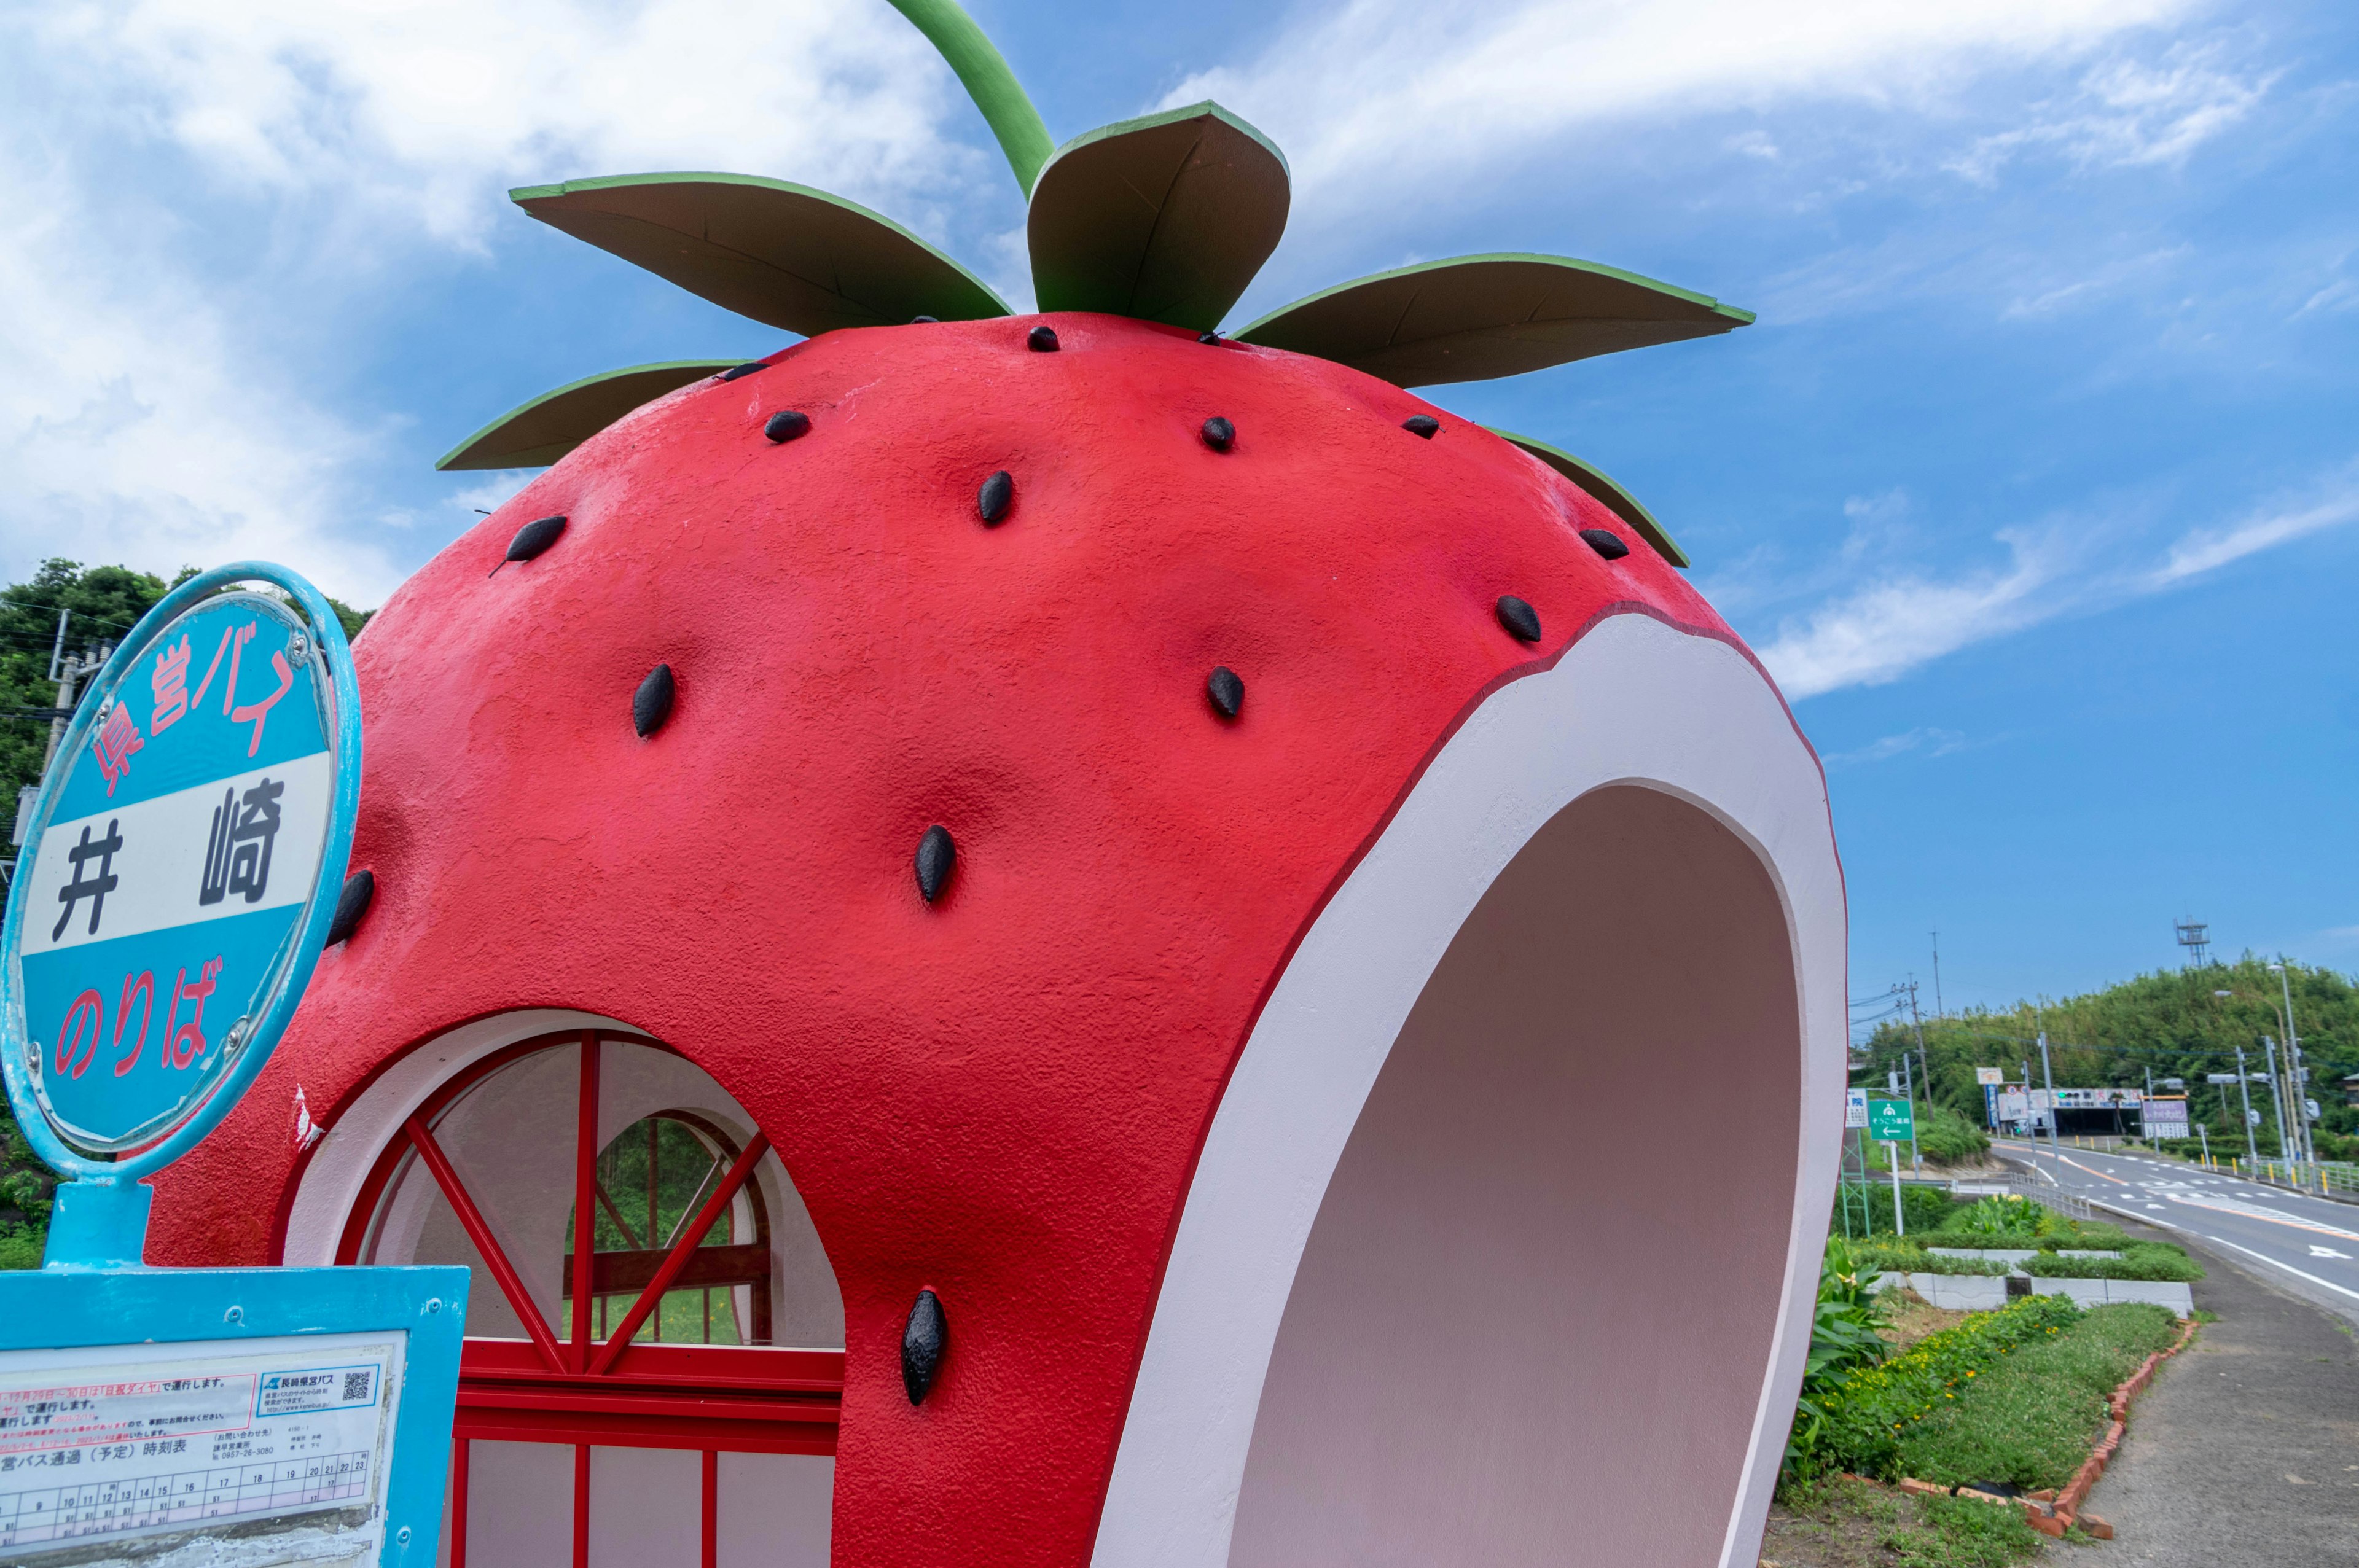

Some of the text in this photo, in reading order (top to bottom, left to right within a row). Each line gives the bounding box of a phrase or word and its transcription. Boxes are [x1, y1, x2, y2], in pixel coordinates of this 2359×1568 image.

[95, 620, 293, 798] 県営バス
[52, 778, 284, 942] 井崎
[55, 953, 224, 1080] のりば
[281, 1375, 334, 1388] 長崎県営バス
[36, 1502, 42, 1511] 9
[64, 1498, 74, 1507] 10
[84, 1496, 93, 1505] 11
[103, 1493, 112, 1502] 12
[122, 1491, 131, 1500] 13
[140, 1488, 149, 1497] 14
[158, 1486, 167, 1496] 15
[185, 1483, 194, 1492] 16
[220, 1479, 229, 1488] 17
[310, 1467, 319, 1476] 20
[340, 1463, 349, 1472] 22
[355, 1461, 364, 1470] 23
[222, 1447, 273, 1459] 0957-26-3080
